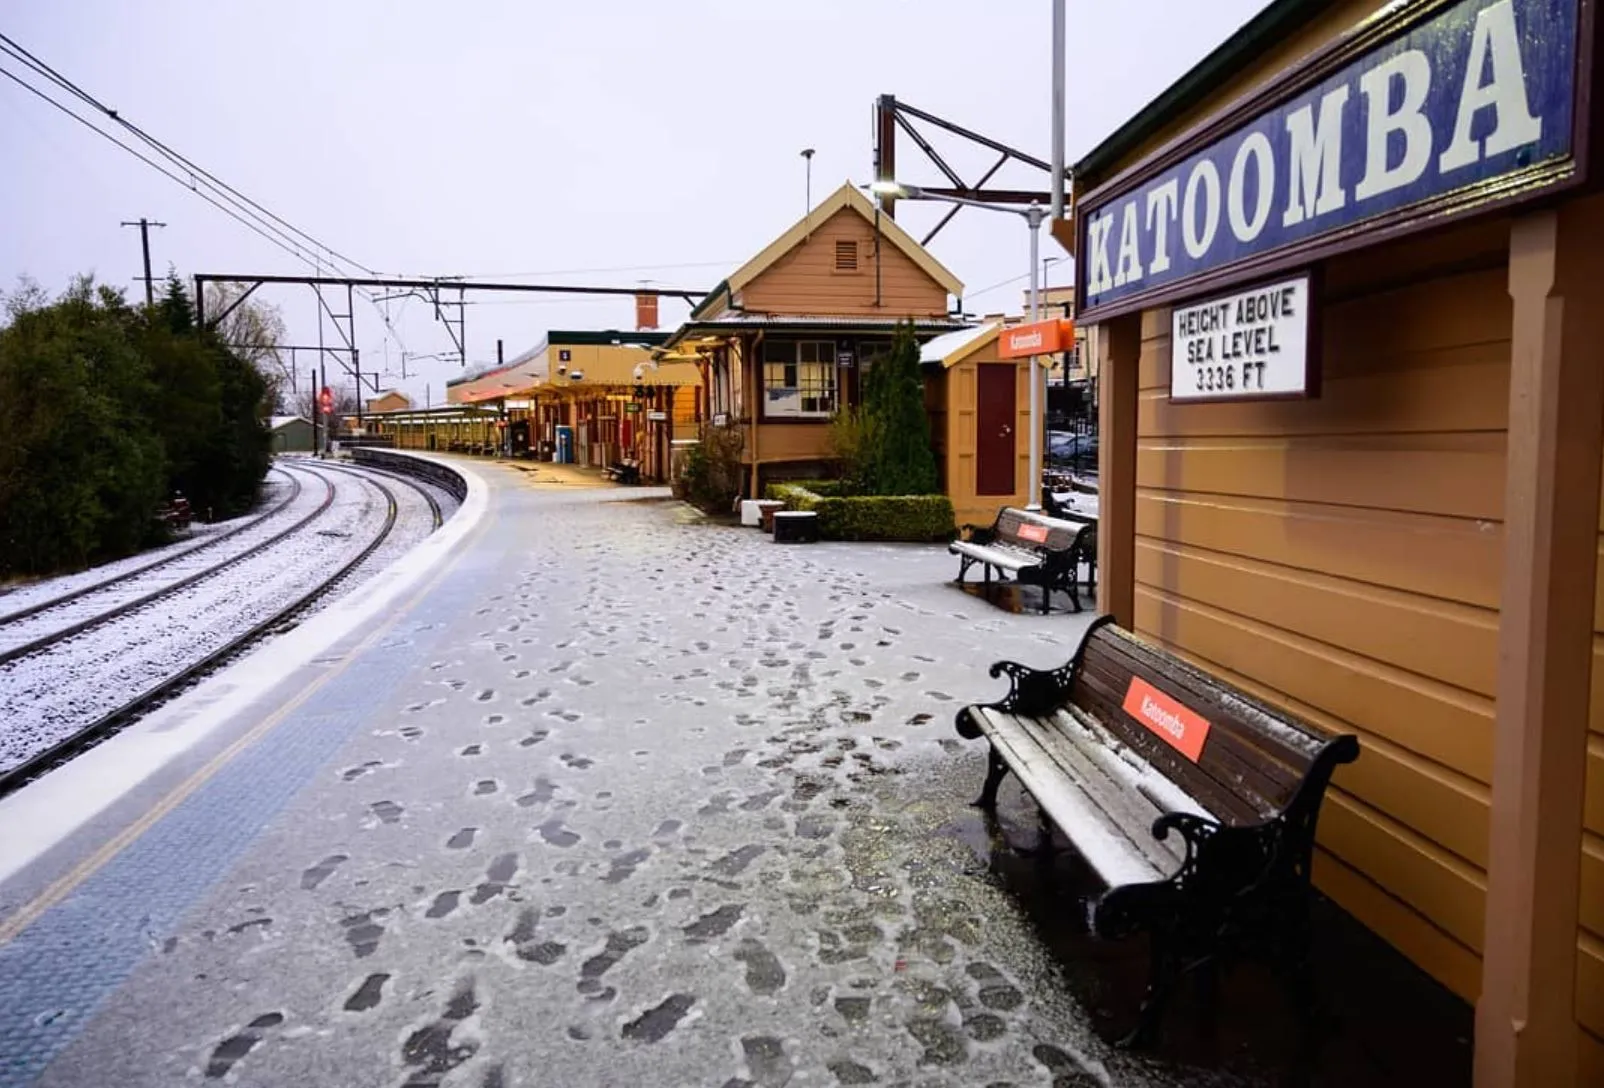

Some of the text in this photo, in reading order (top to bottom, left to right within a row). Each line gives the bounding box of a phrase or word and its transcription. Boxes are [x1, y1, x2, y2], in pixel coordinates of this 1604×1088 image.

[1086, 4, 1543, 298] KATOOMBA
[1178, 286, 1296, 339] HEIGHT ABOVE
[1187, 325, 1281, 364] SEA LEVEL
[1196, 360, 1267, 391] 3336 FT
[1140, 694, 1185, 740] Katoomba
